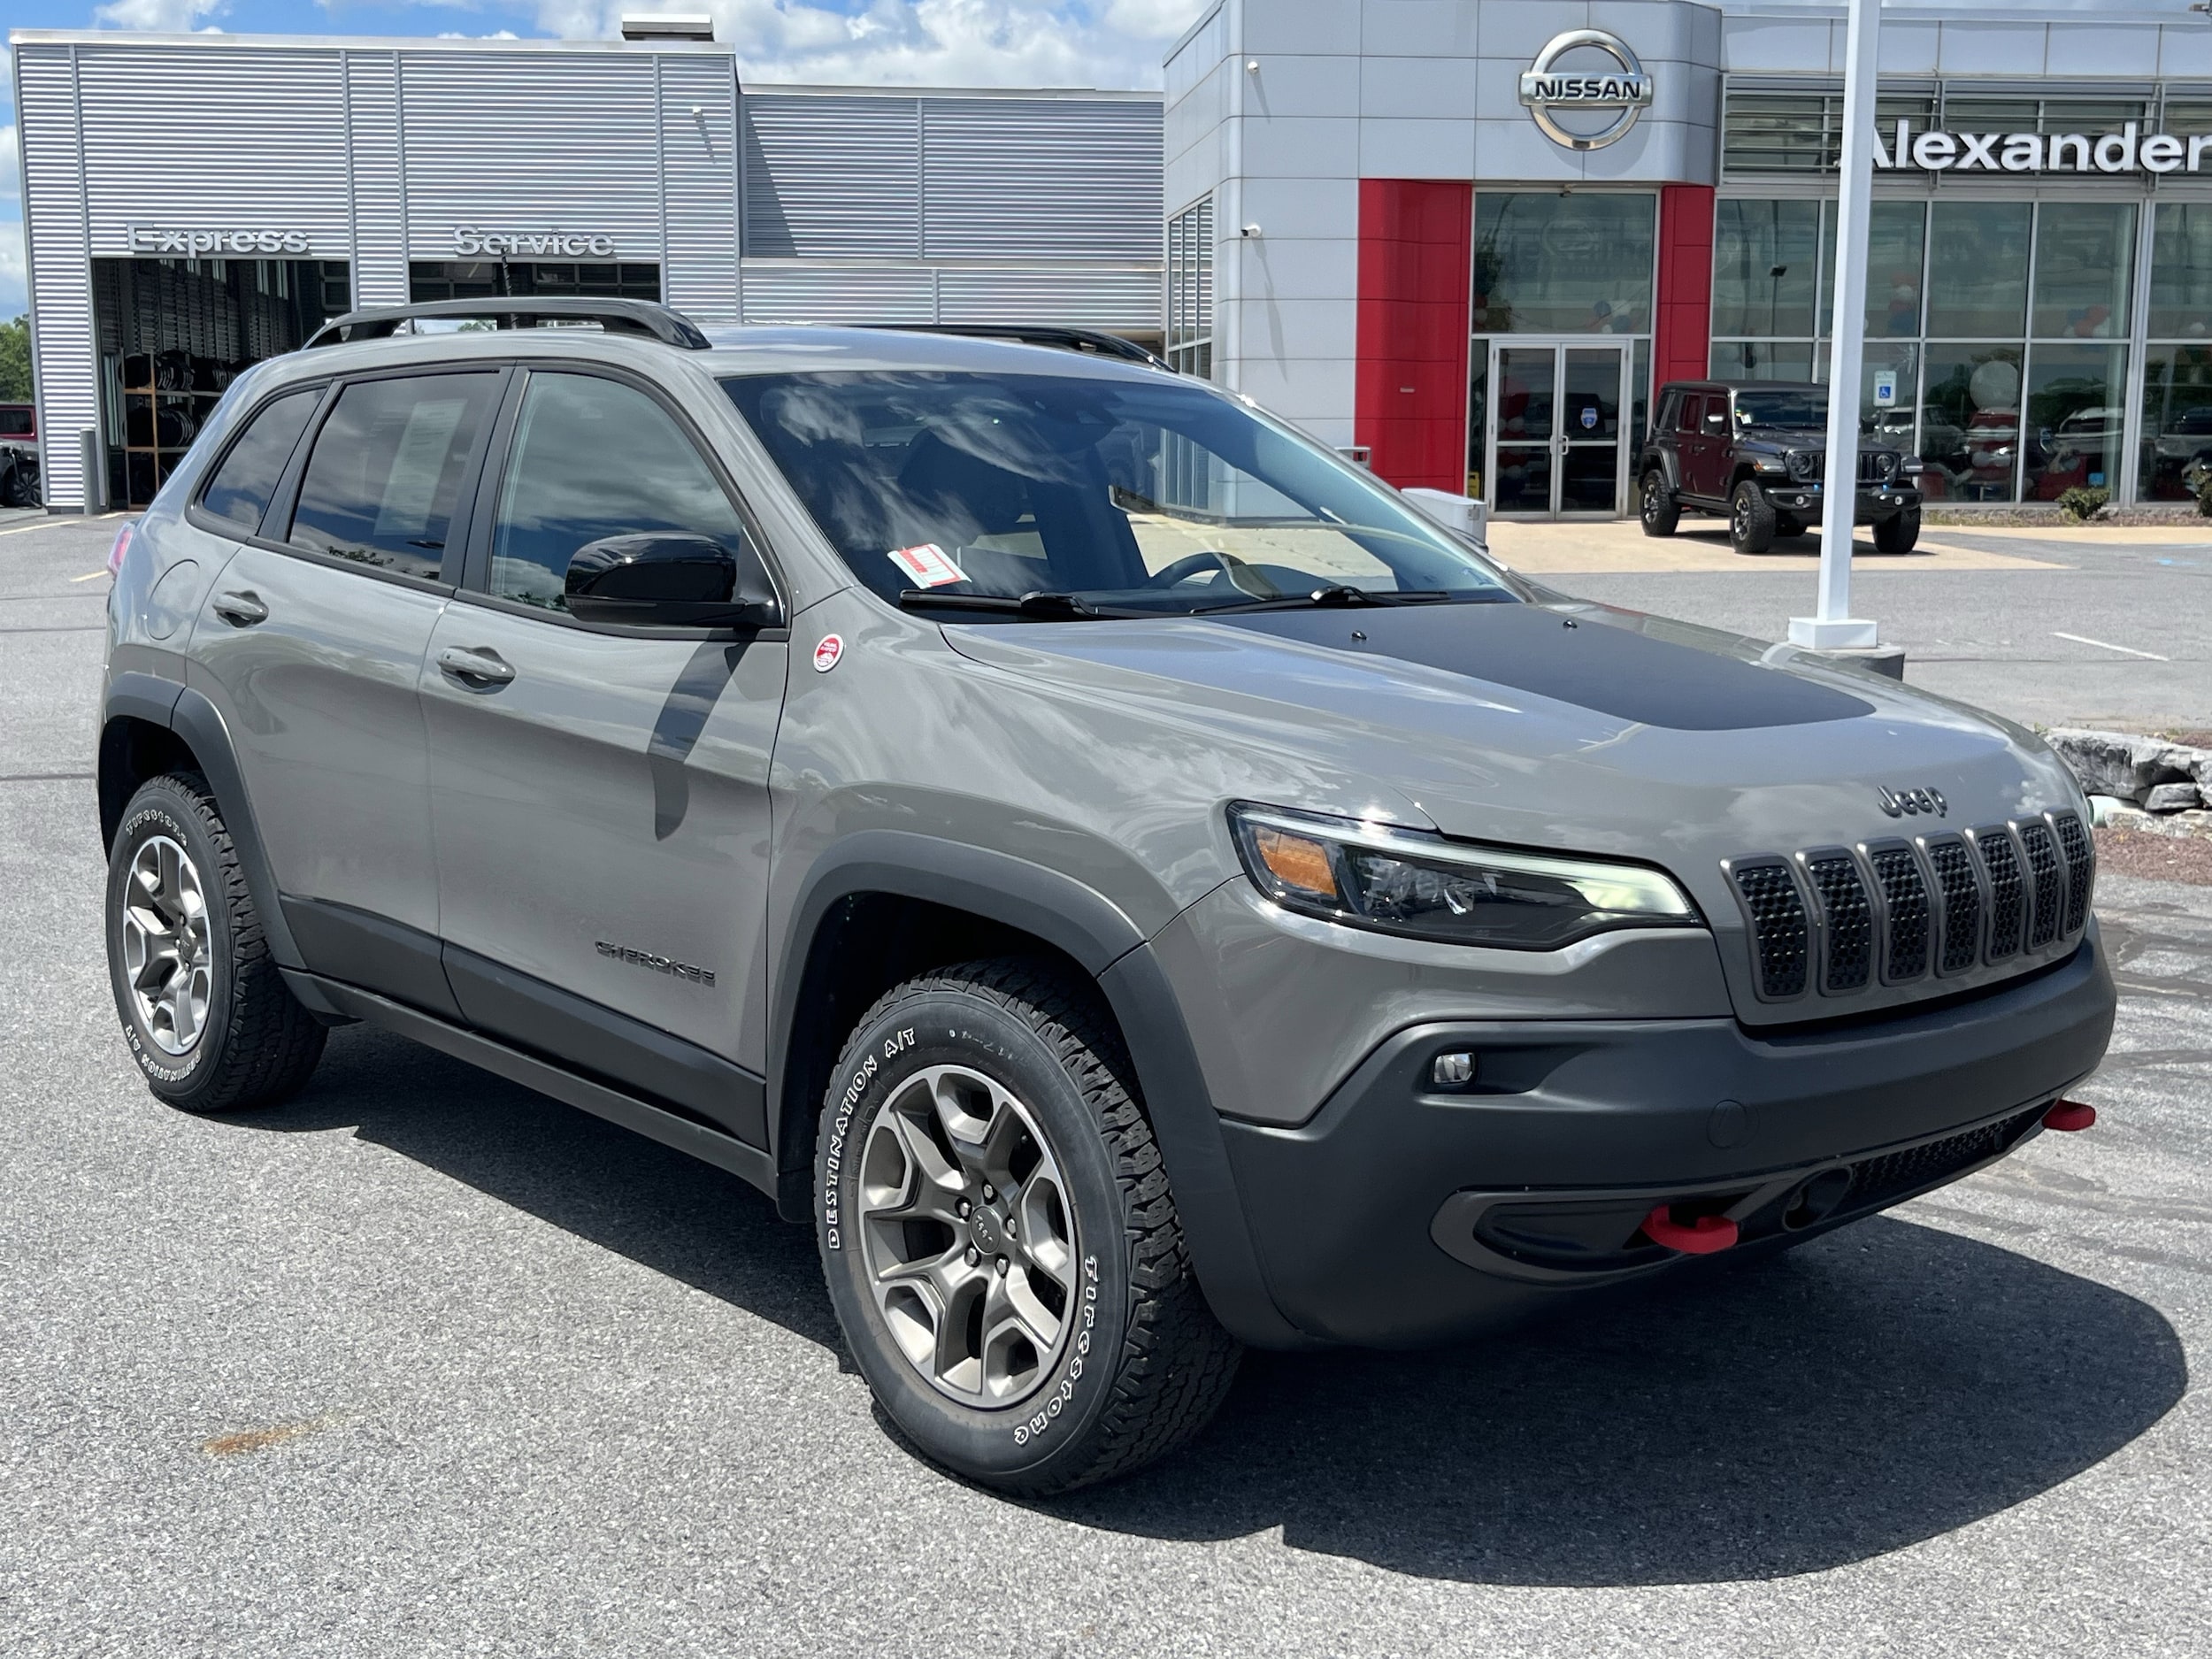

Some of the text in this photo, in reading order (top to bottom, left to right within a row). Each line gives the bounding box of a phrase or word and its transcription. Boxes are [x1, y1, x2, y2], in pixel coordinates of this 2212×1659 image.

[1534, 79, 1643, 101] NISSAN
[127, 221, 615, 259] Express Service
[1877, 785, 1948, 818] Jeep
[595, 940, 716, 988] CHEROKEE
[826, 1054, 878, 1249] DESTINATION
[885, 1027, 916, 1058] A/T
[1014, 1255, 1099, 1445] Firestone
